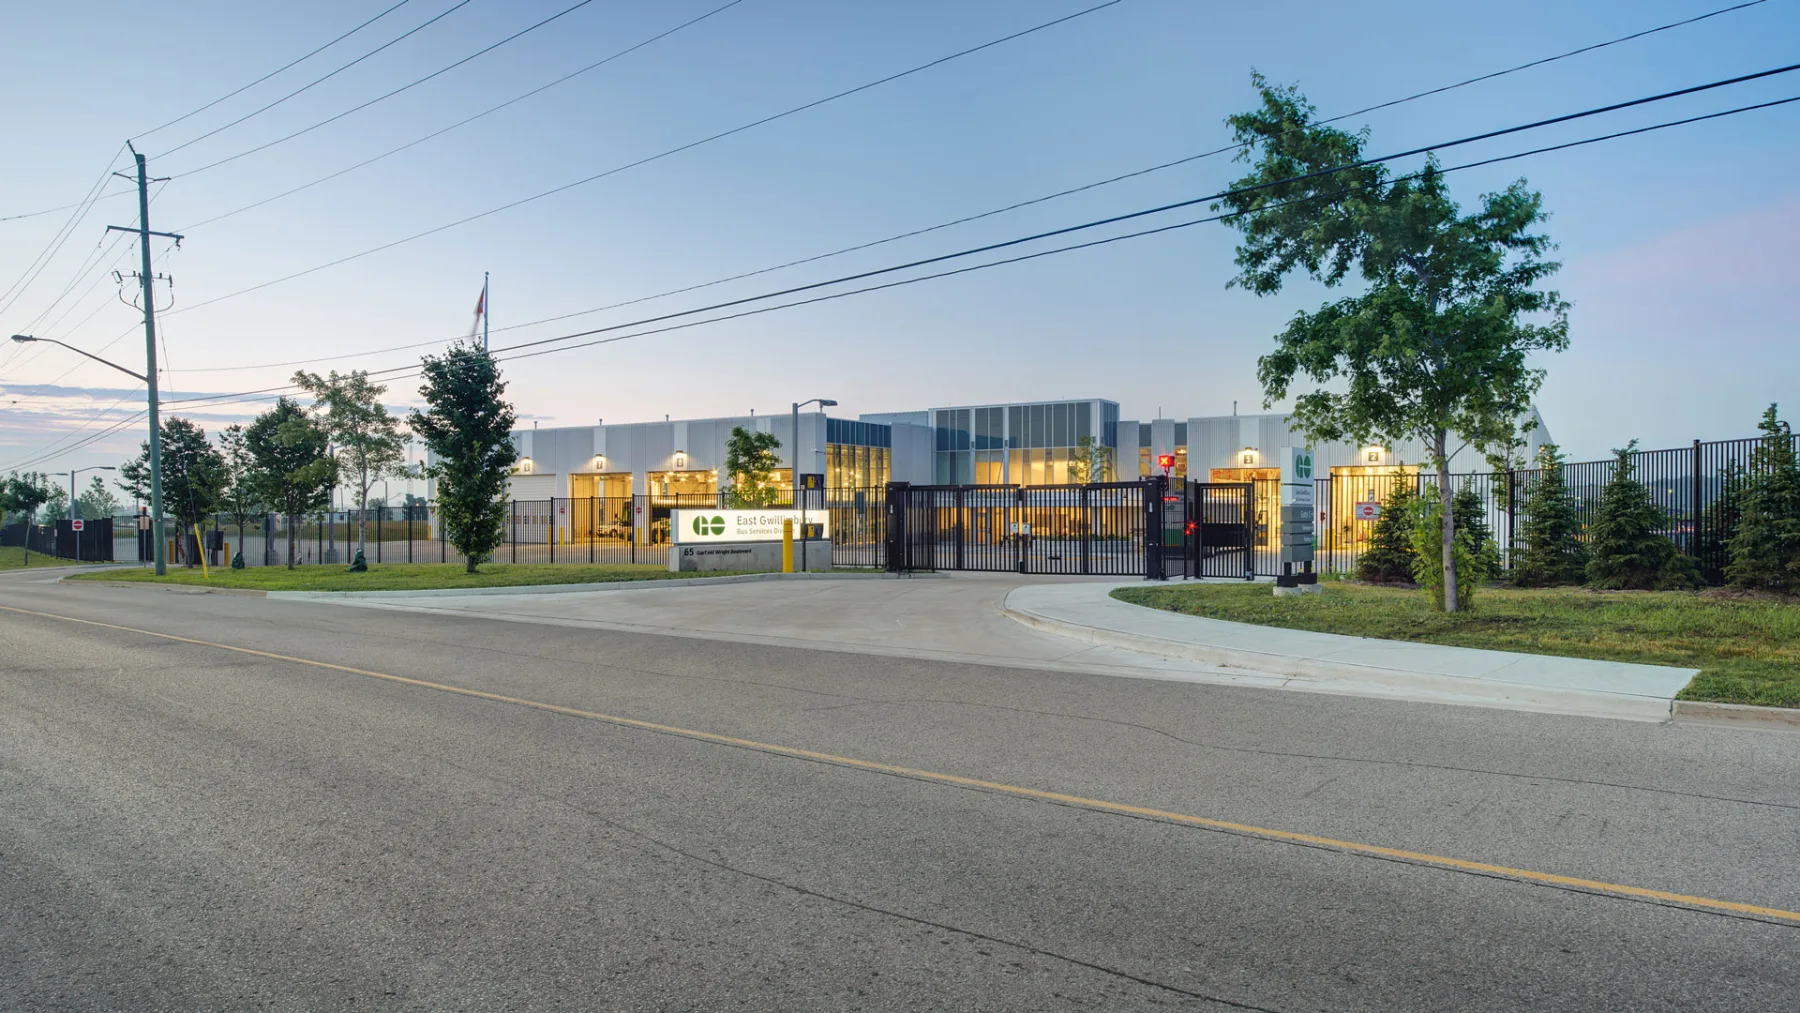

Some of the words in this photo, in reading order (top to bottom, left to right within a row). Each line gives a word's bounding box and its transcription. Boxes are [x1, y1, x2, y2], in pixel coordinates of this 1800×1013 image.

[692, 515, 726, 536] GO
[736, 515, 757, 526] East
[760, 515, 813, 526] Gwillbry
[684, 548, 694, 556] 65
